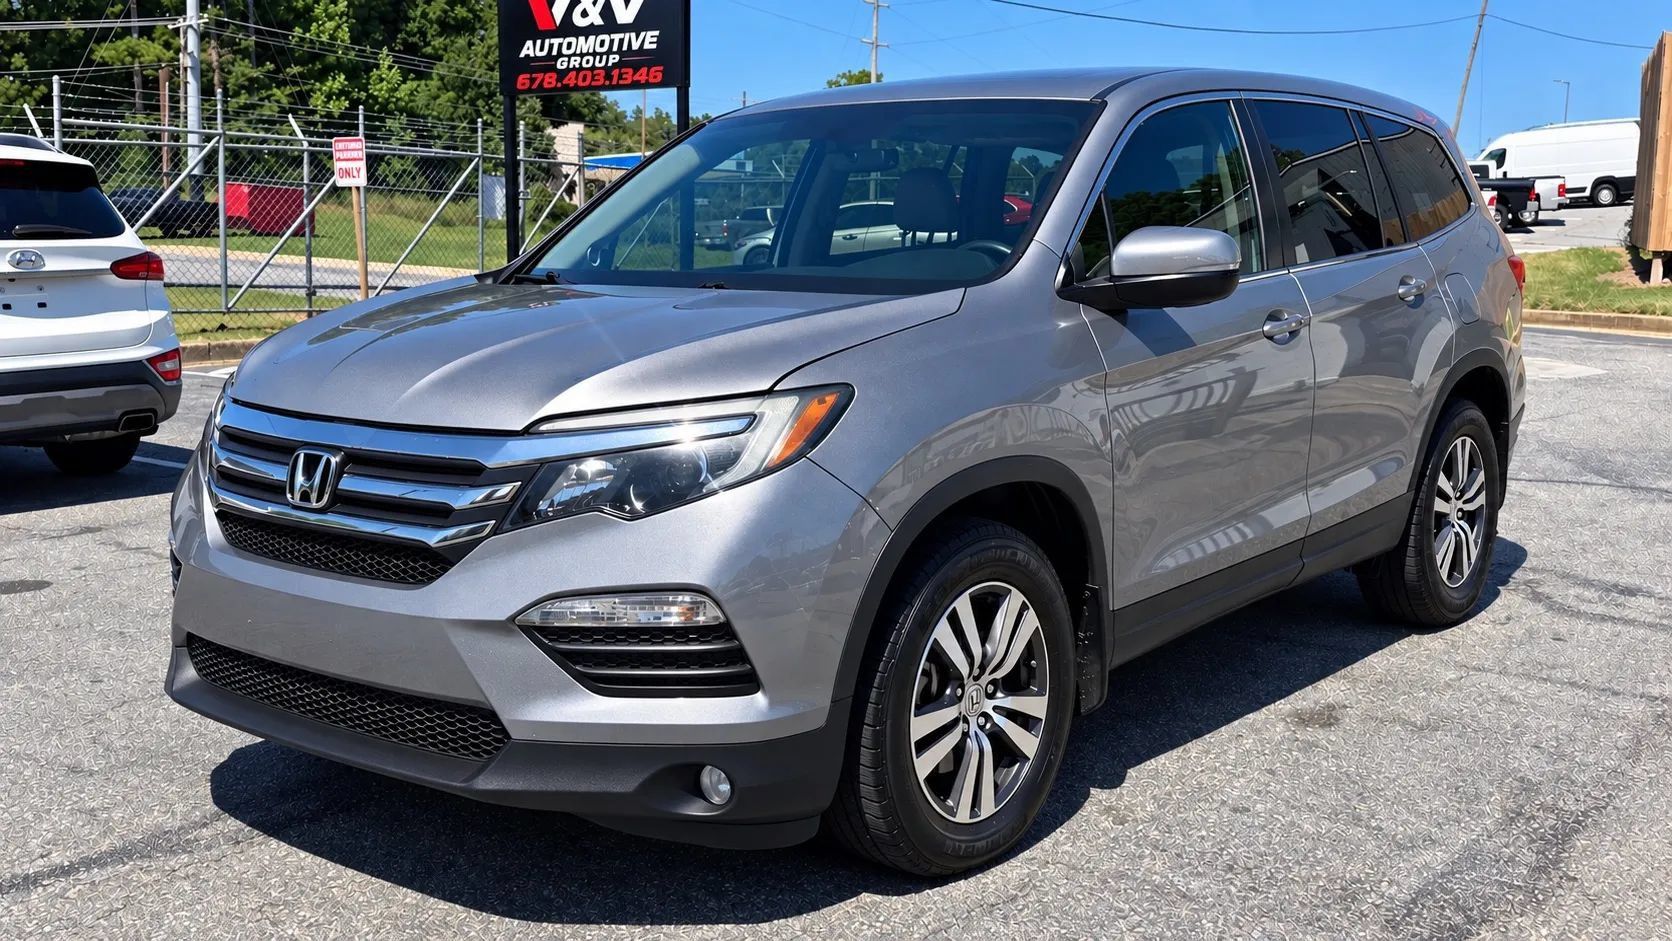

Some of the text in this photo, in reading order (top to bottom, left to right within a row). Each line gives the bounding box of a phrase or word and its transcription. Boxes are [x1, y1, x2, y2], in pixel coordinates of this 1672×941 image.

[519, 30, 660, 58] AUTOMOTIVE
[556, 54, 620, 70] GROUP
[516, 66, 664, 91] 678.403.1346
[338, 167, 361, 179] ONLY
